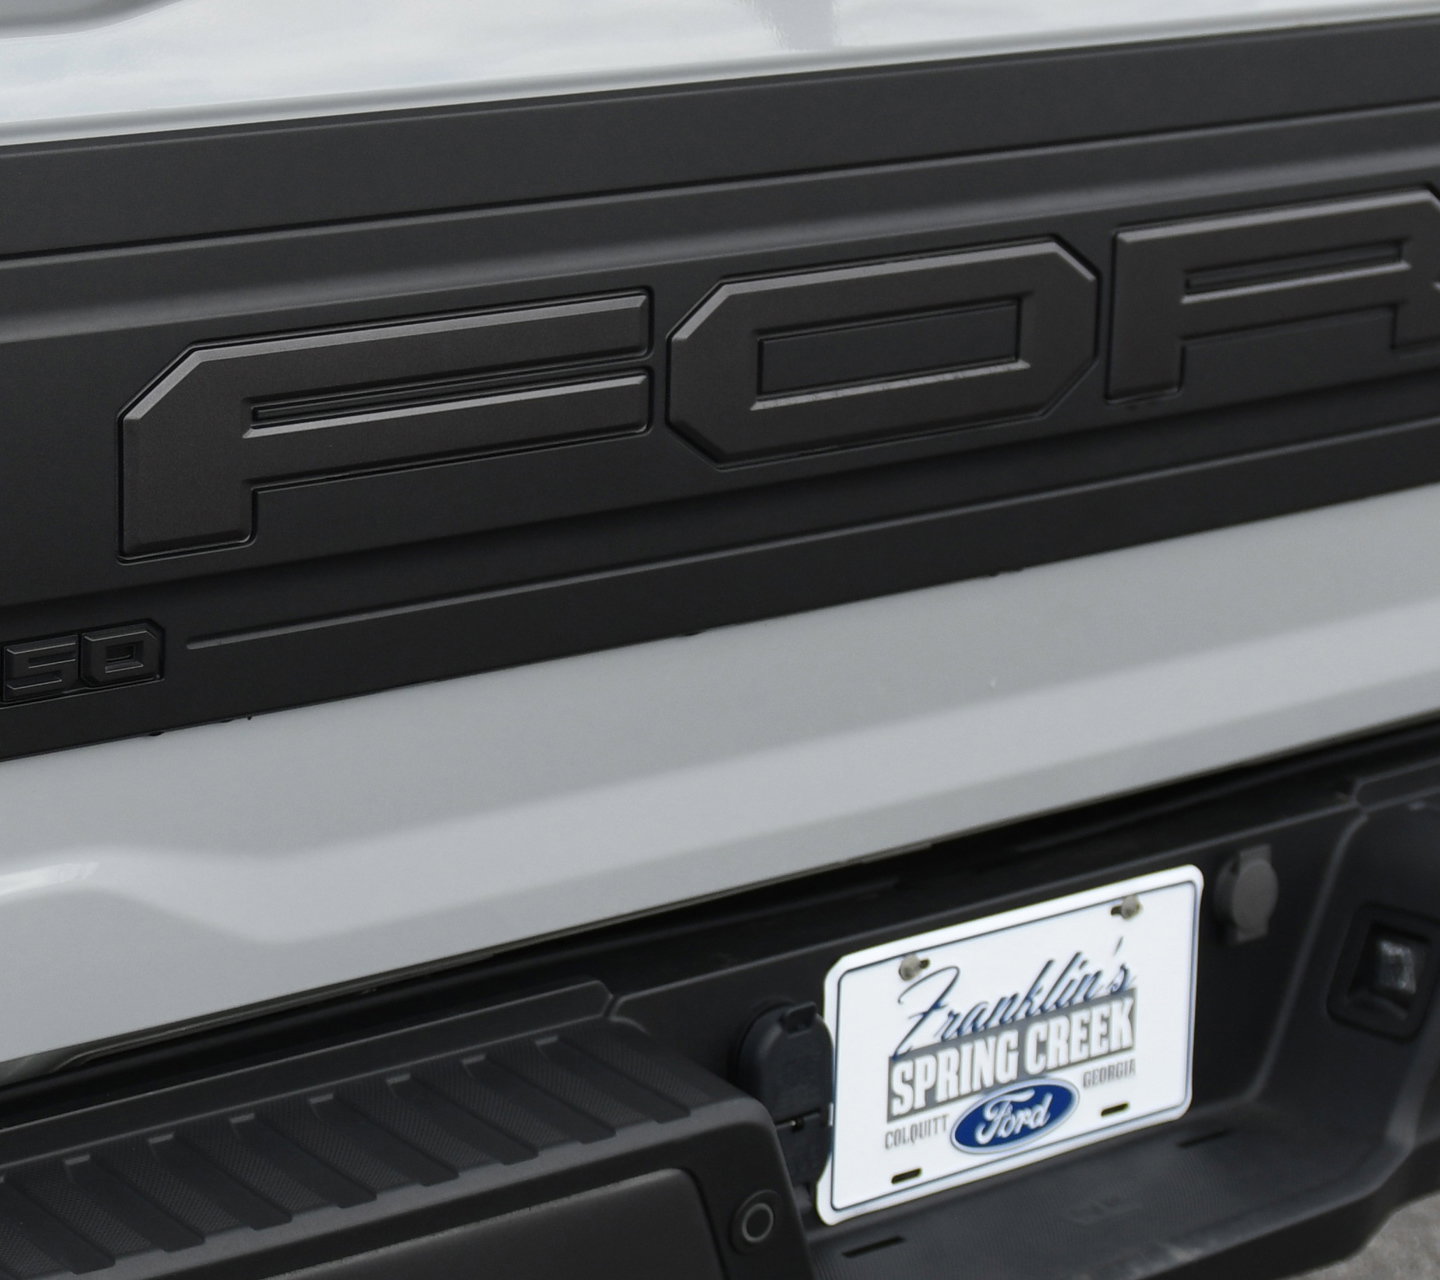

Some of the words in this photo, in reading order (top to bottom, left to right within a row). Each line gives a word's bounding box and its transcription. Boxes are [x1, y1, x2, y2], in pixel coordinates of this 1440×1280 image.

[892, 937, 1134, 1060] Franklin's
[892, 1030, 1019, 1115] SPRING
[1025, 998, 1134, 1075] CREEK
[1083, 1060, 1135, 1088] GEORGIA
[885, 1115, 948, 1149] COLQUITT
[974, 1088, 1054, 1145] Ford
